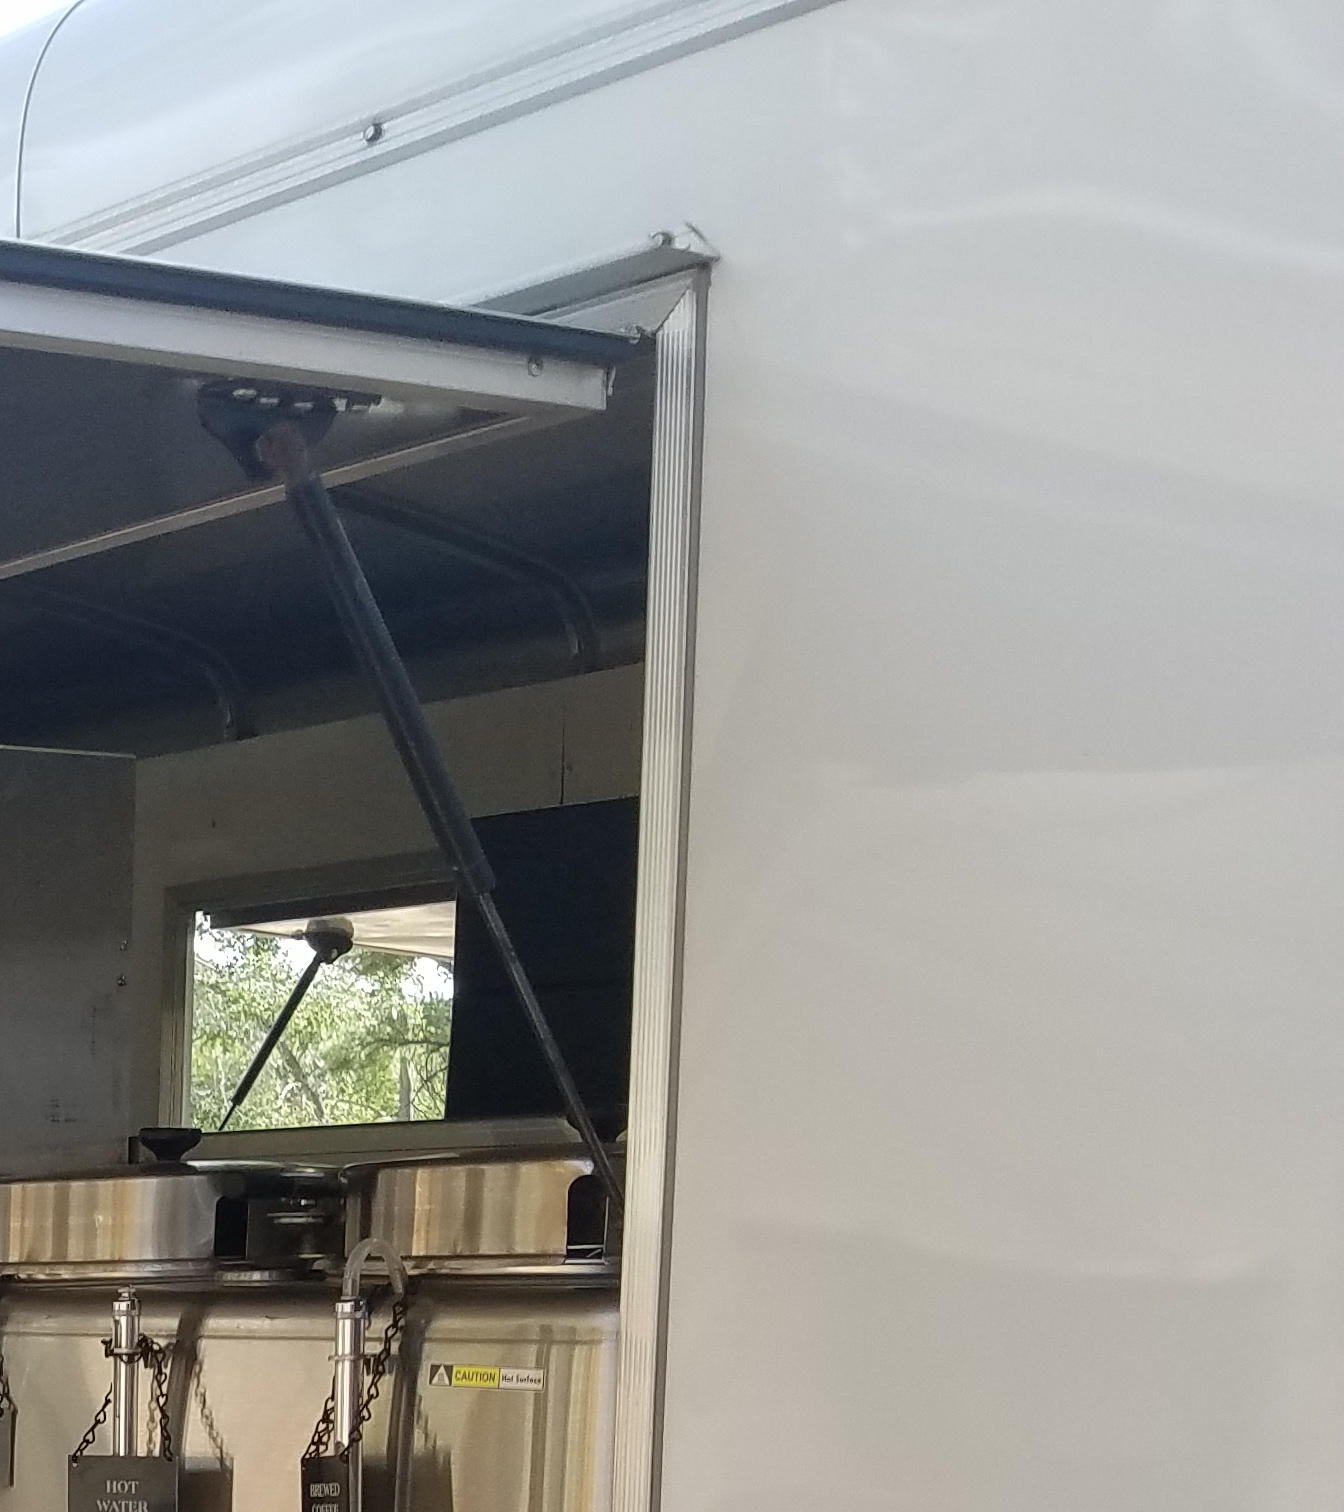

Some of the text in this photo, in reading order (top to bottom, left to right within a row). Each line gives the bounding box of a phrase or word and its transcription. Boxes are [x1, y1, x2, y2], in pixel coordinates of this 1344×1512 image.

[454, 1370, 496, 1383] CAUTION
[106, 1480, 139, 1494] HOT
[310, 1482, 341, 1497] BREWED
